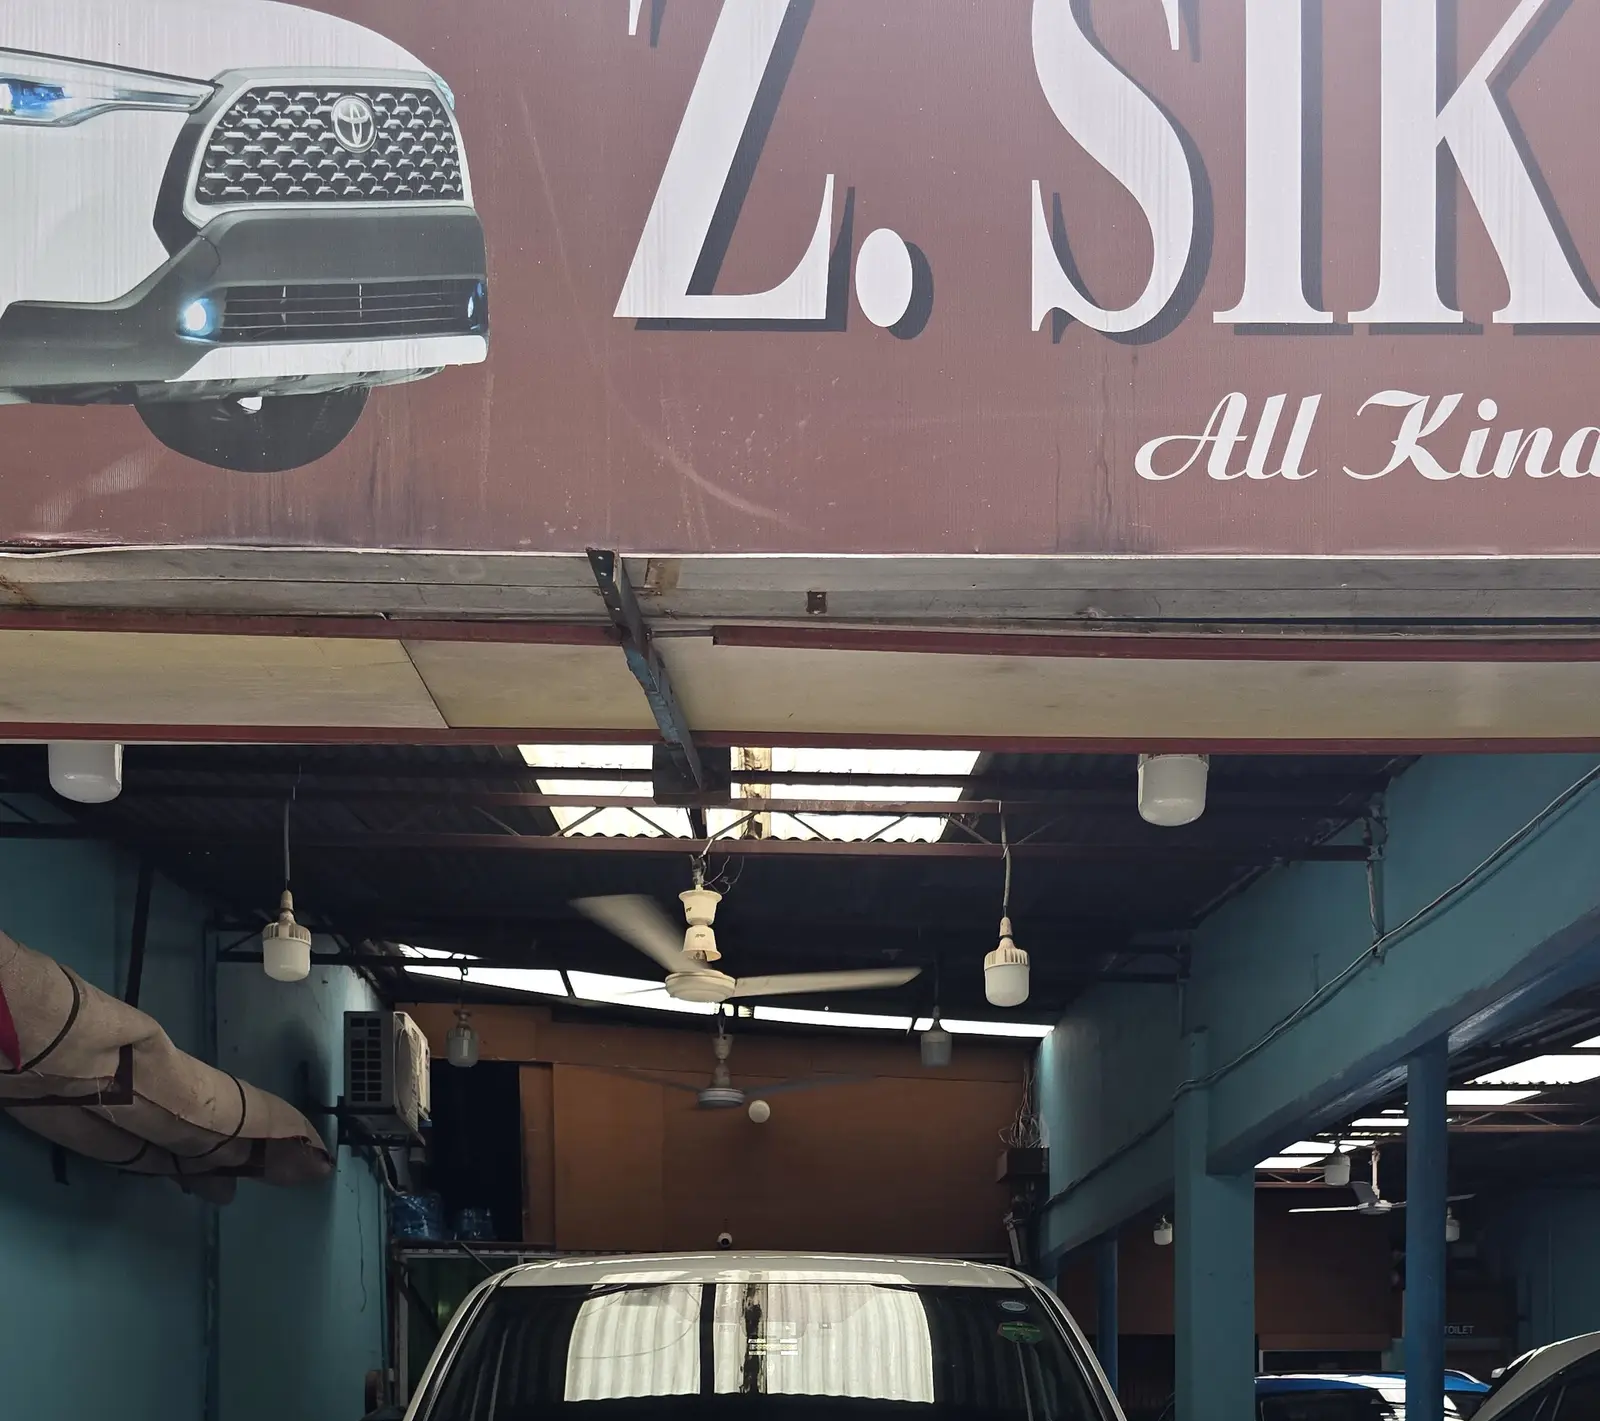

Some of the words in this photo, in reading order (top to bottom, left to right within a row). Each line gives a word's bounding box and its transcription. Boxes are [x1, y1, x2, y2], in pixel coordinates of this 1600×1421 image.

[613, 0, 913, 328] Z.
[1031, 0, 1600, 333] SIK
[1133, 391, 1323, 481] All
